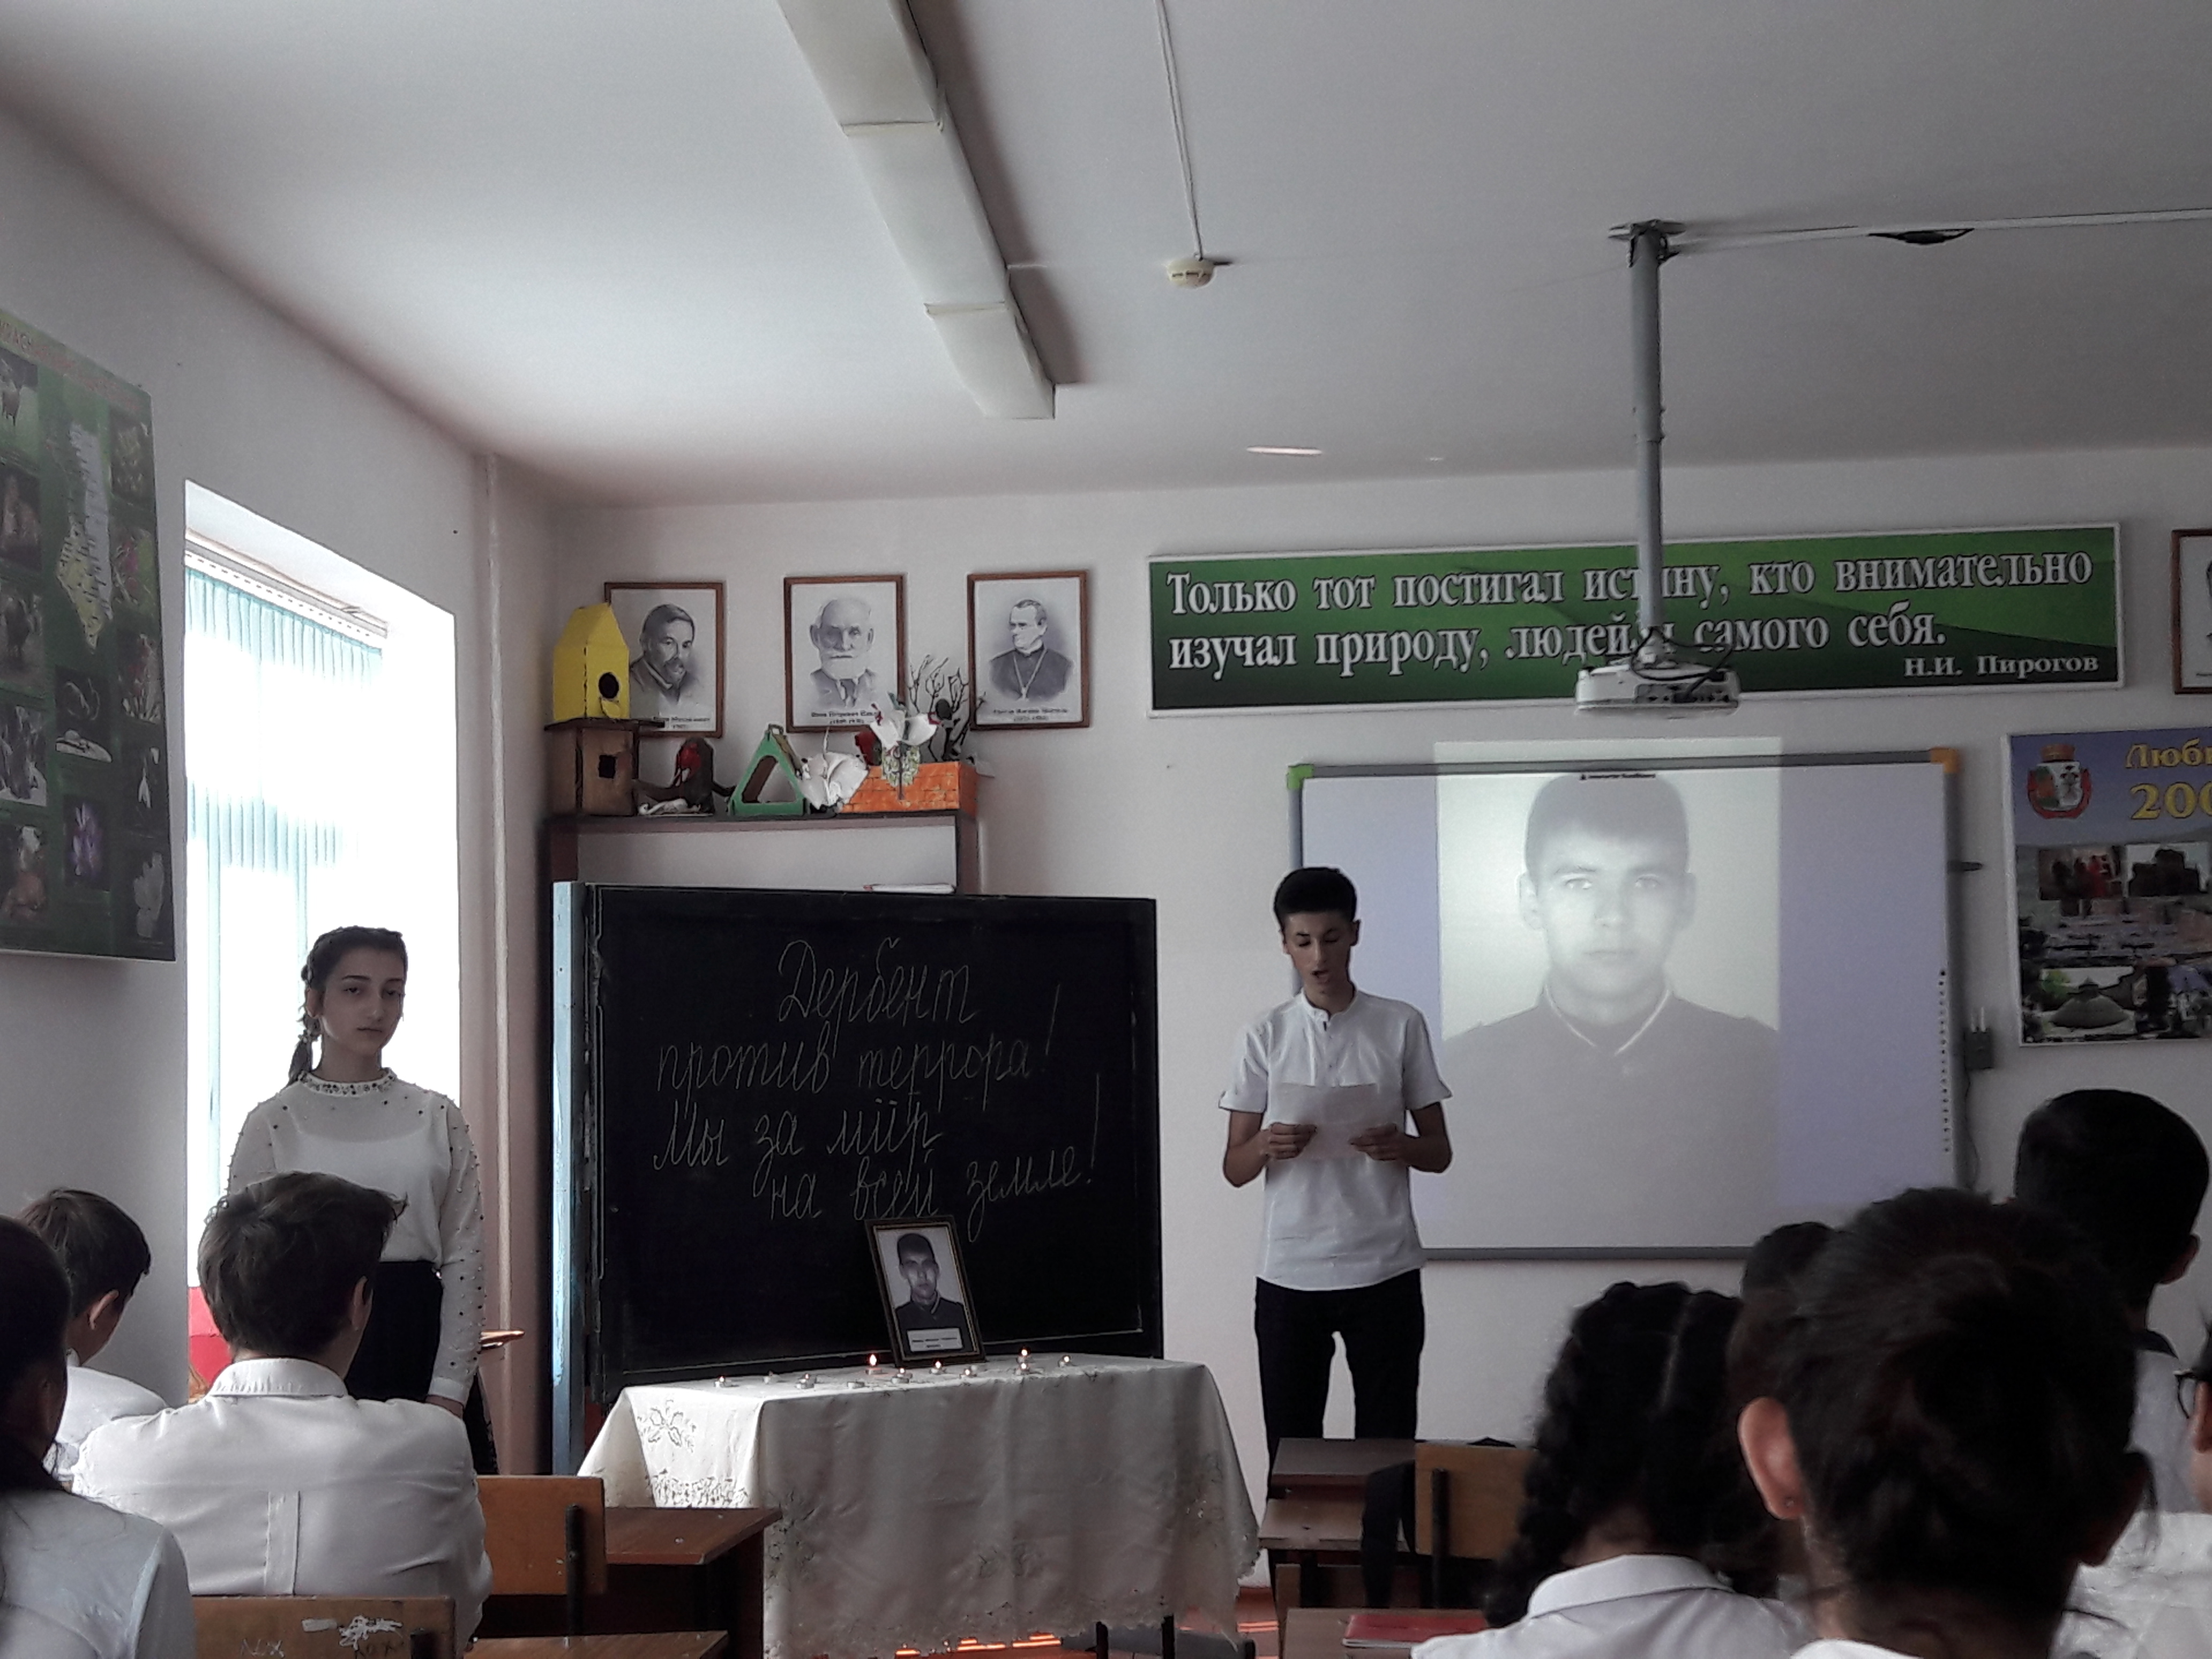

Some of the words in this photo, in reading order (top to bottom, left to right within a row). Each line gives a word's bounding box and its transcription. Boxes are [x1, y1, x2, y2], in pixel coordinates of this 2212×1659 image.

[1165, 571, 1297, 615] Только
[1313, 575, 1376, 610] тот
[1393, 570, 1565, 607] постигал
[1748, 561, 1815, 594] кто
[1834, 551, 2092, 591] внимательно
[1169, 634, 1297, 681] изучал
[1314, 629, 1489, 677] природу,
[1693, 617, 1830, 652] самого
[1848, 599, 1947, 647] себя.
[1976, 654, 2100, 679] Пирогов
[778, 937, 980, 1058] Дербент
[657, 1020, 834, 1119] против
[858, 983, 1061, 1114] террора!
[653, 1099, 730, 1170] Мы
[752, 1109, 804, 1198] за
[769, 1171, 824, 1221] на
[849, 1149, 940, 1221] всей
[966, 1072, 1101, 1243] земле!
